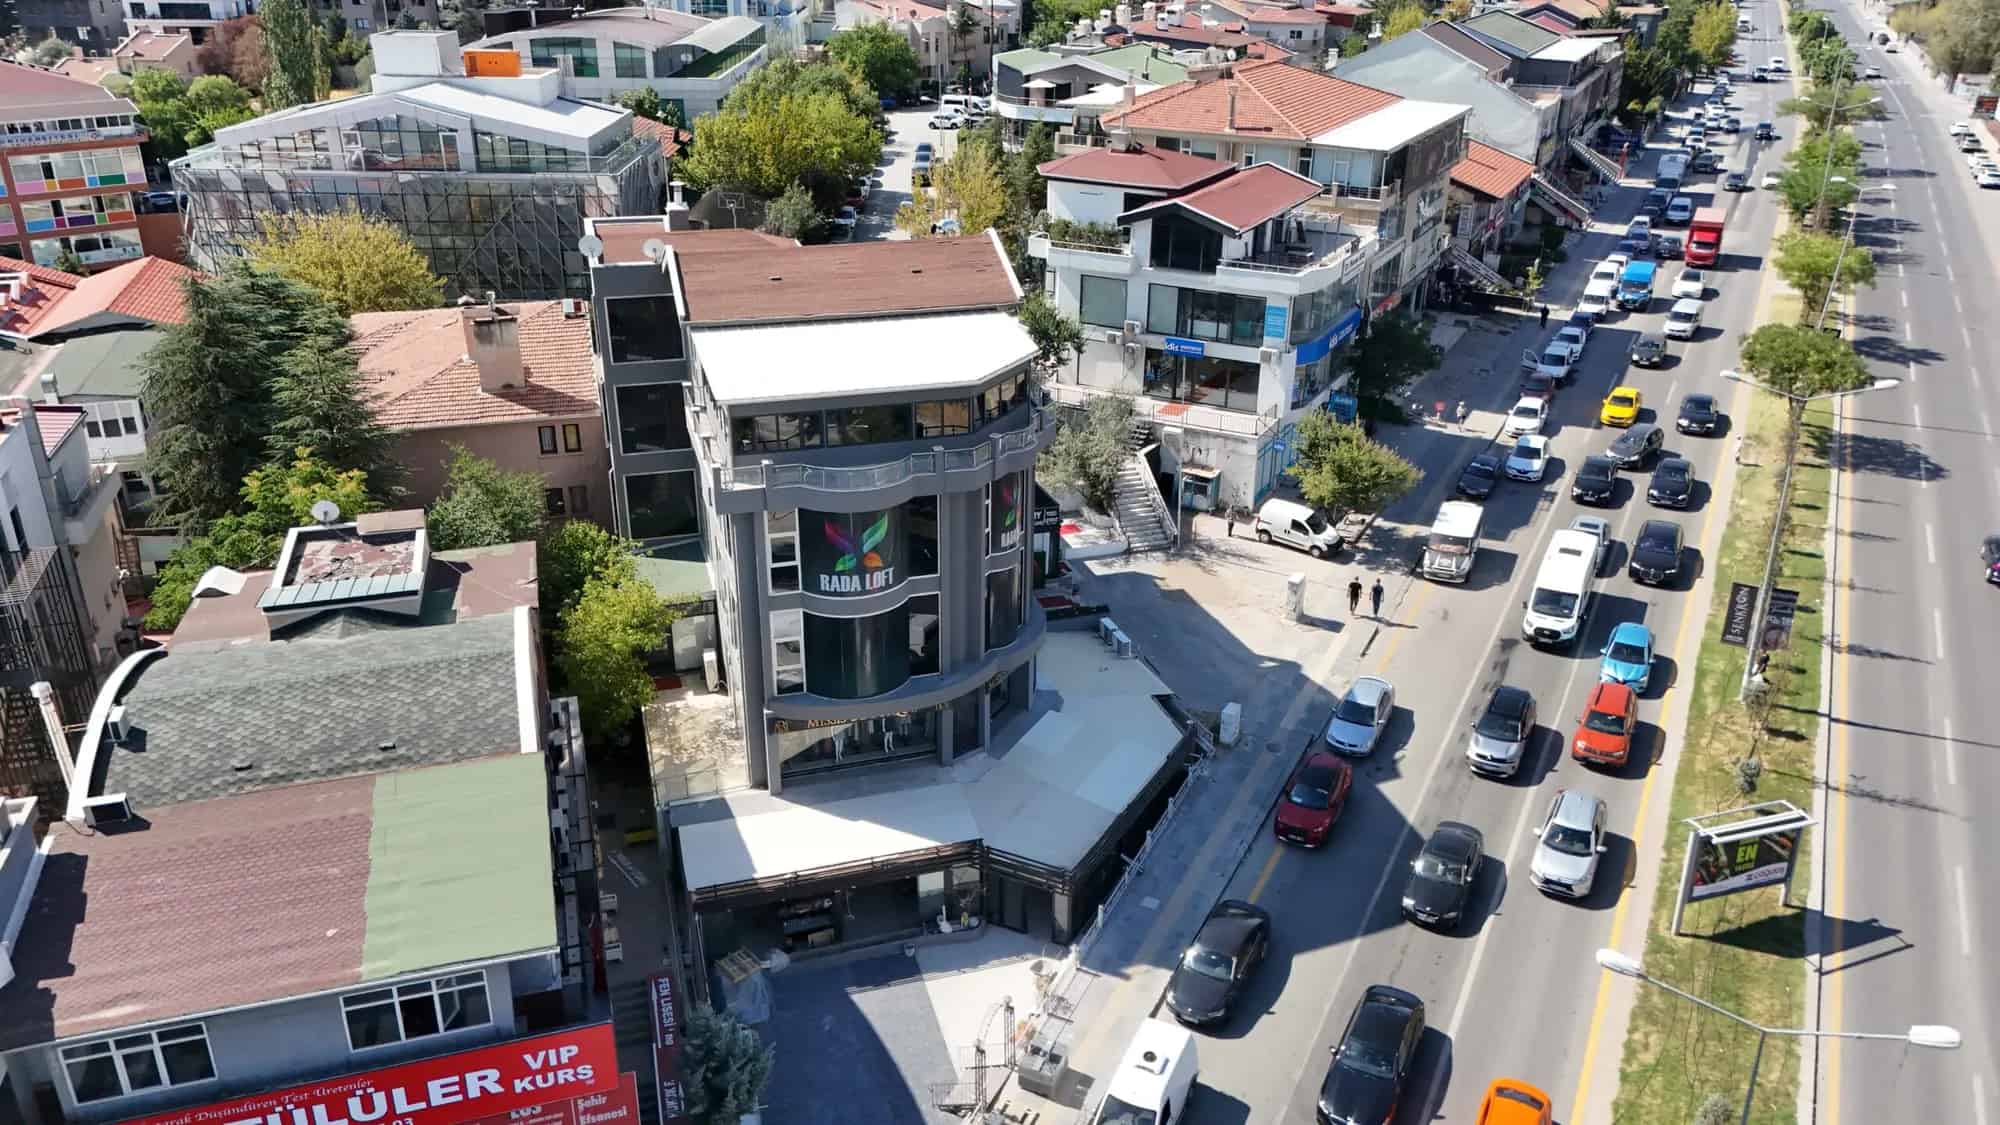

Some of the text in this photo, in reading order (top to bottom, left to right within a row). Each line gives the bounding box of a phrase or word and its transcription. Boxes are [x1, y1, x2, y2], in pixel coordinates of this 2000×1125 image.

[819, 566, 895, 593] RADA LOFT
[1736, 844, 1759, 864] EN
[523, 1044, 580, 1070] VIP
[513, 1064, 594, 1094] KURS
